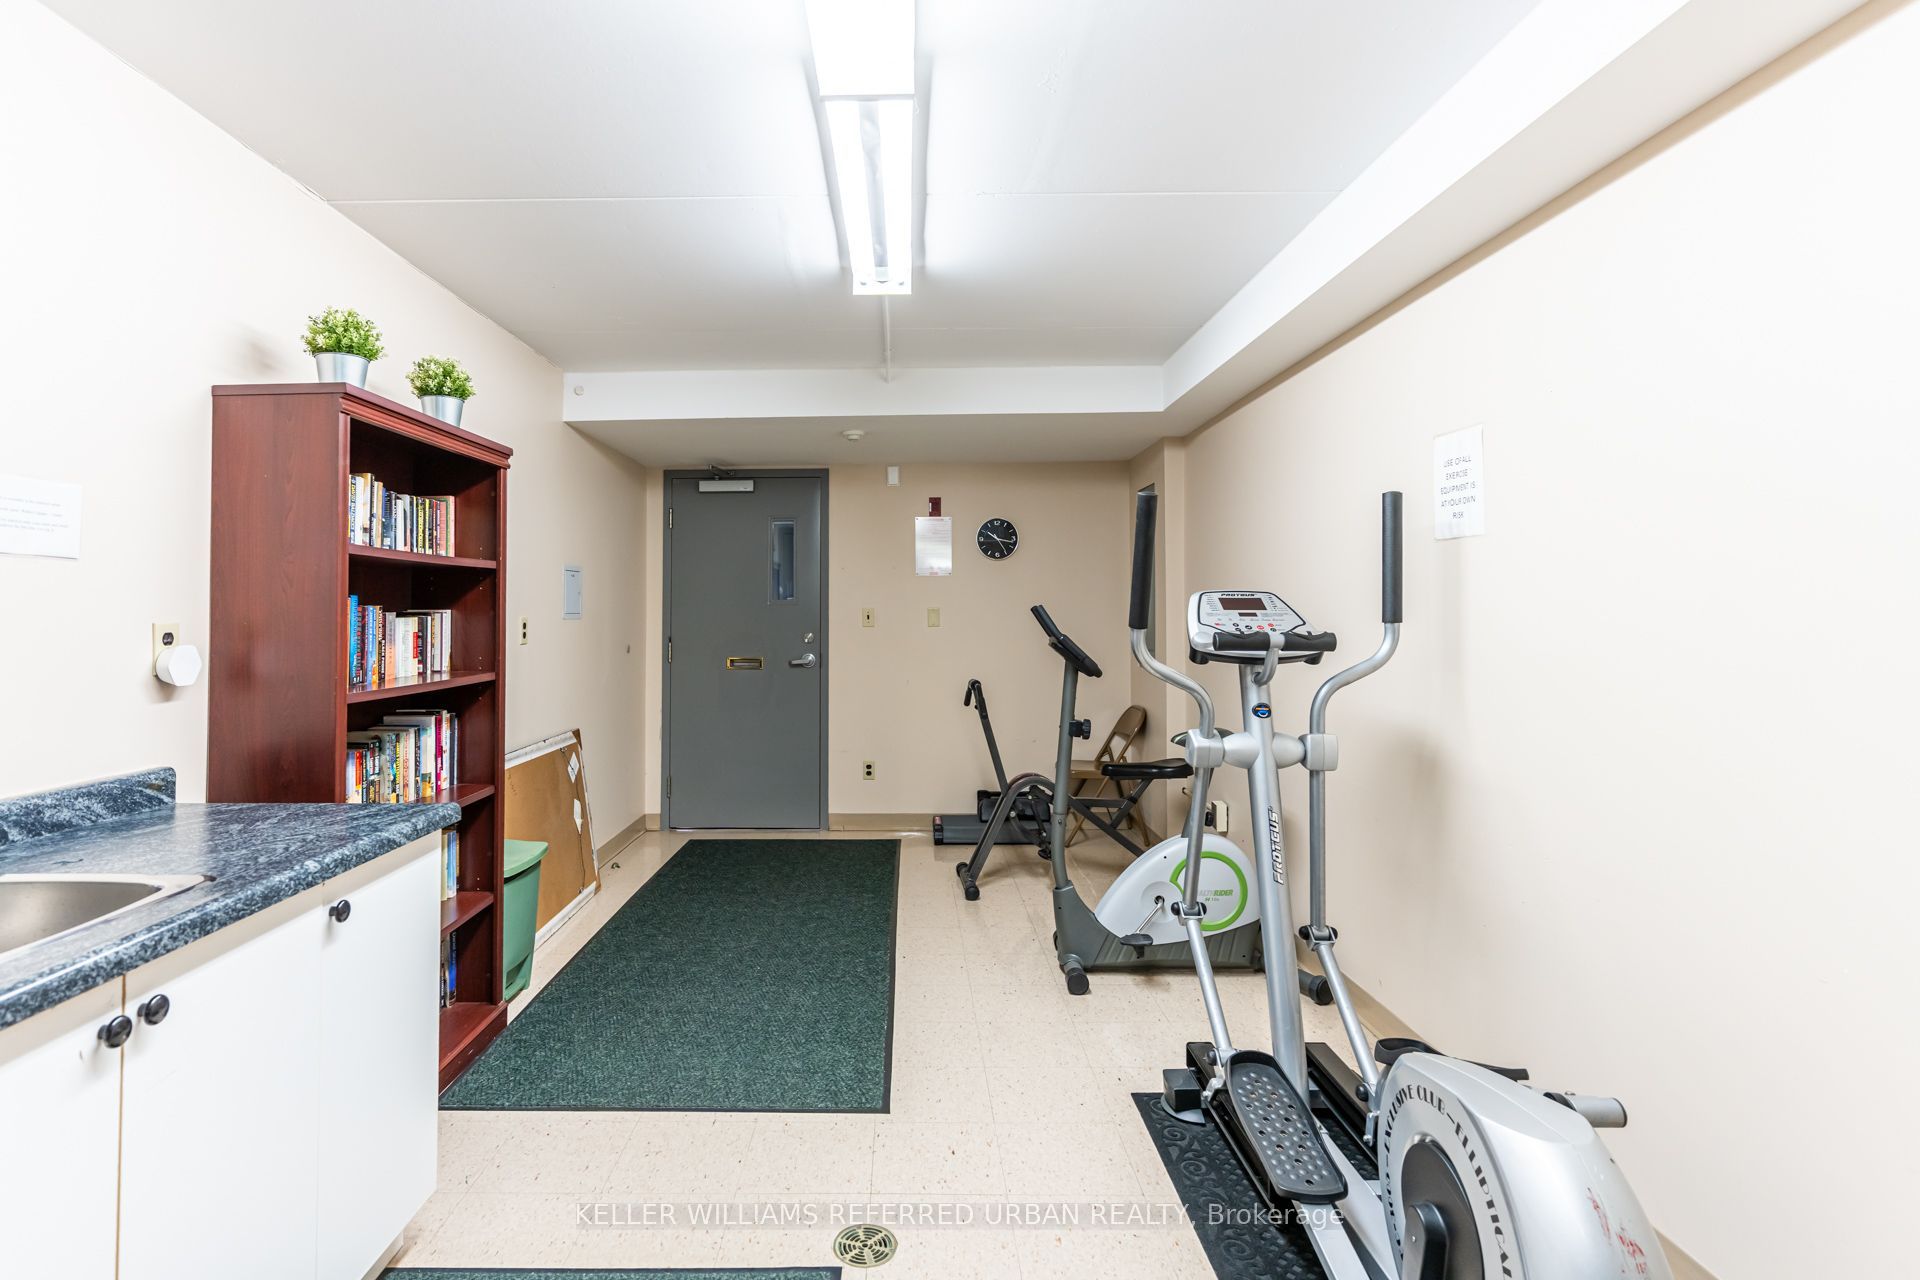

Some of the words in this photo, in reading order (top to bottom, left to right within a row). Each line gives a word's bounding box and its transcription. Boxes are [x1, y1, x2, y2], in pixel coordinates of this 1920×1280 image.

[1266, 809, 1284, 885] PROTEUS
[1384, 1084, 1414, 1154] EXCLUSIVE
[1416, 1084, 1446, 1115] CLUB
